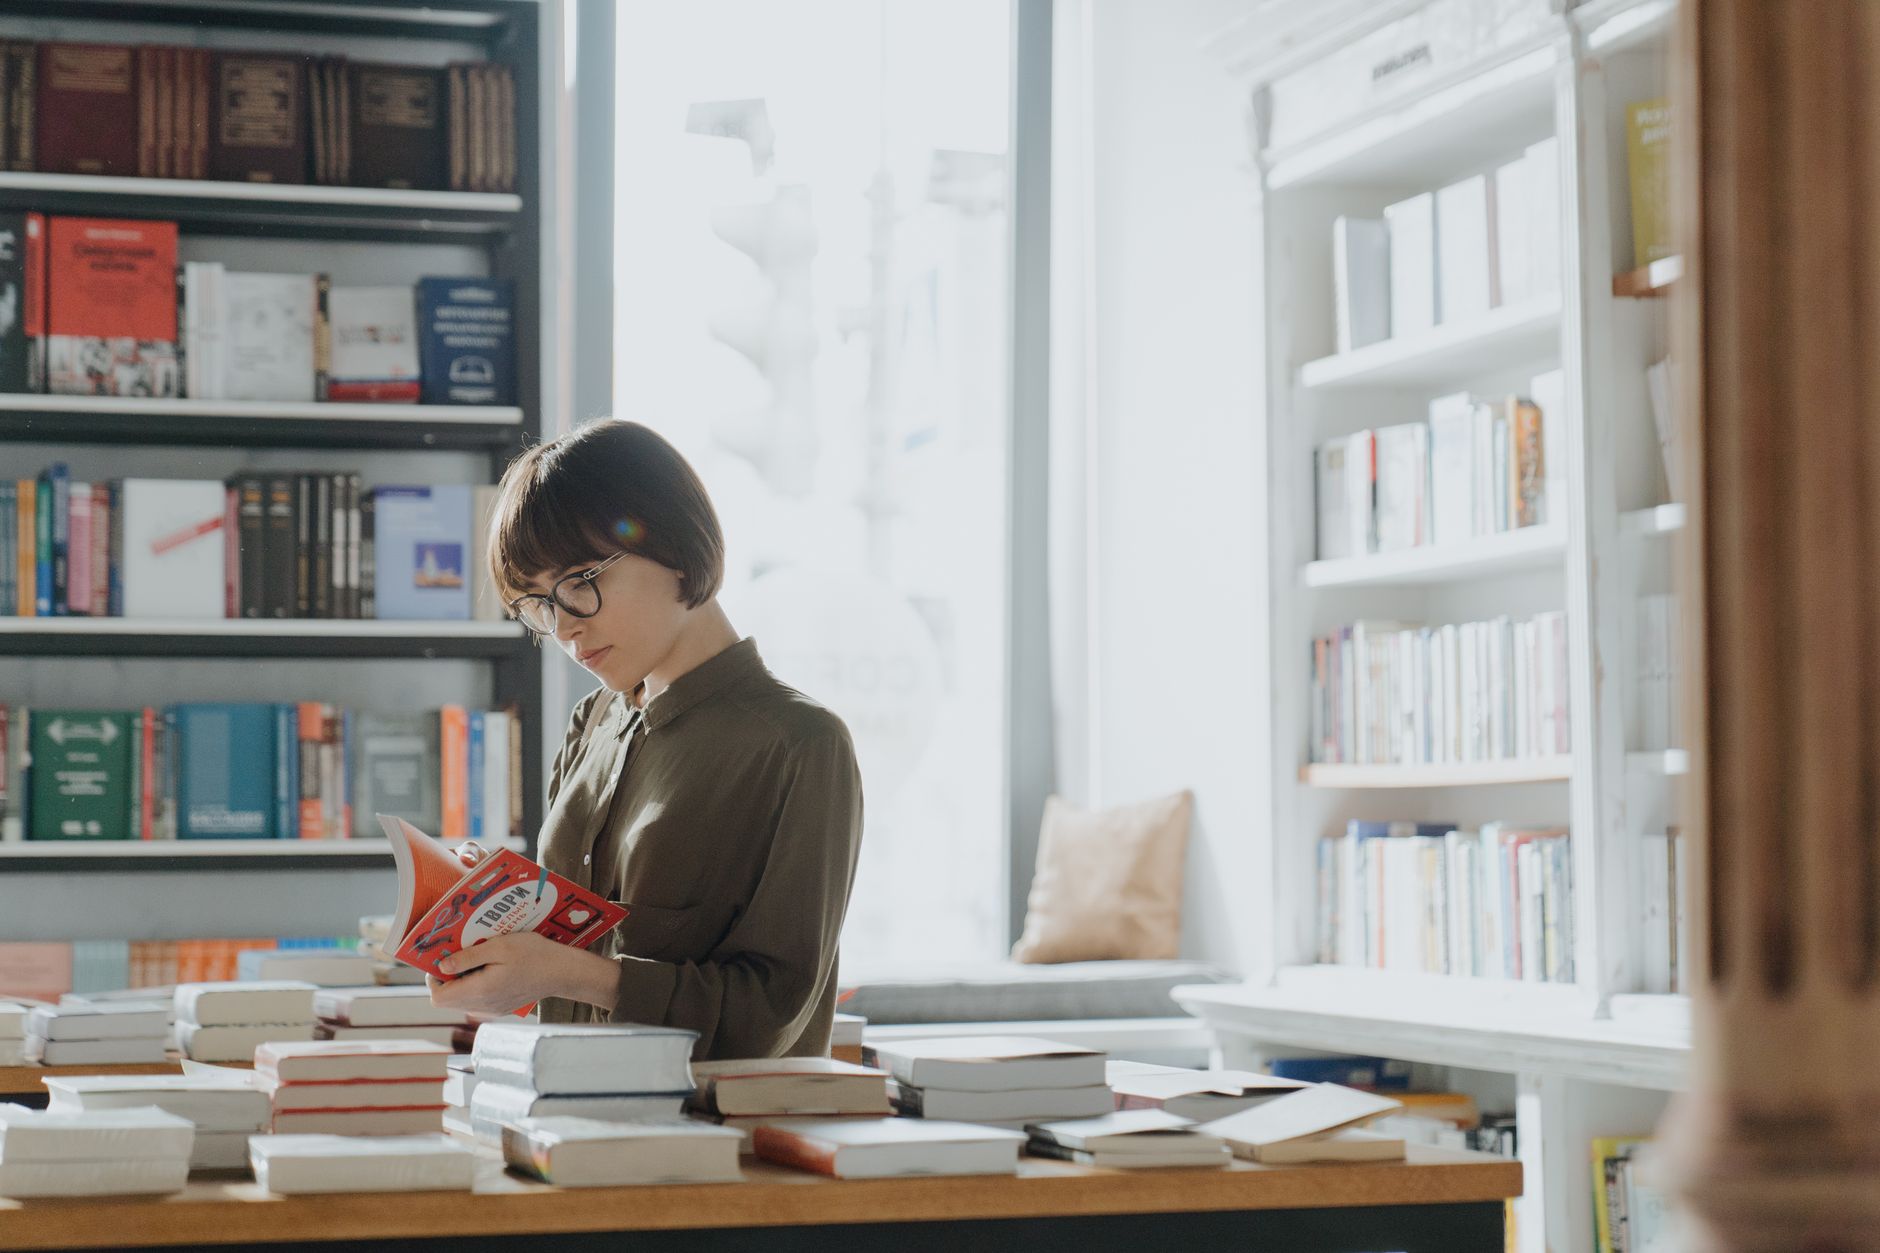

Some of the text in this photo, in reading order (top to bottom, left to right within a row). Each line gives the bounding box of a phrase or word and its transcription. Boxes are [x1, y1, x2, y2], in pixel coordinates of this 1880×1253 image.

[475, 886, 531, 928] ТВОРИ
[493, 901, 529, 932] ЦЕЛЫЙ
[501, 913, 528, 935] ДЕНЬ
